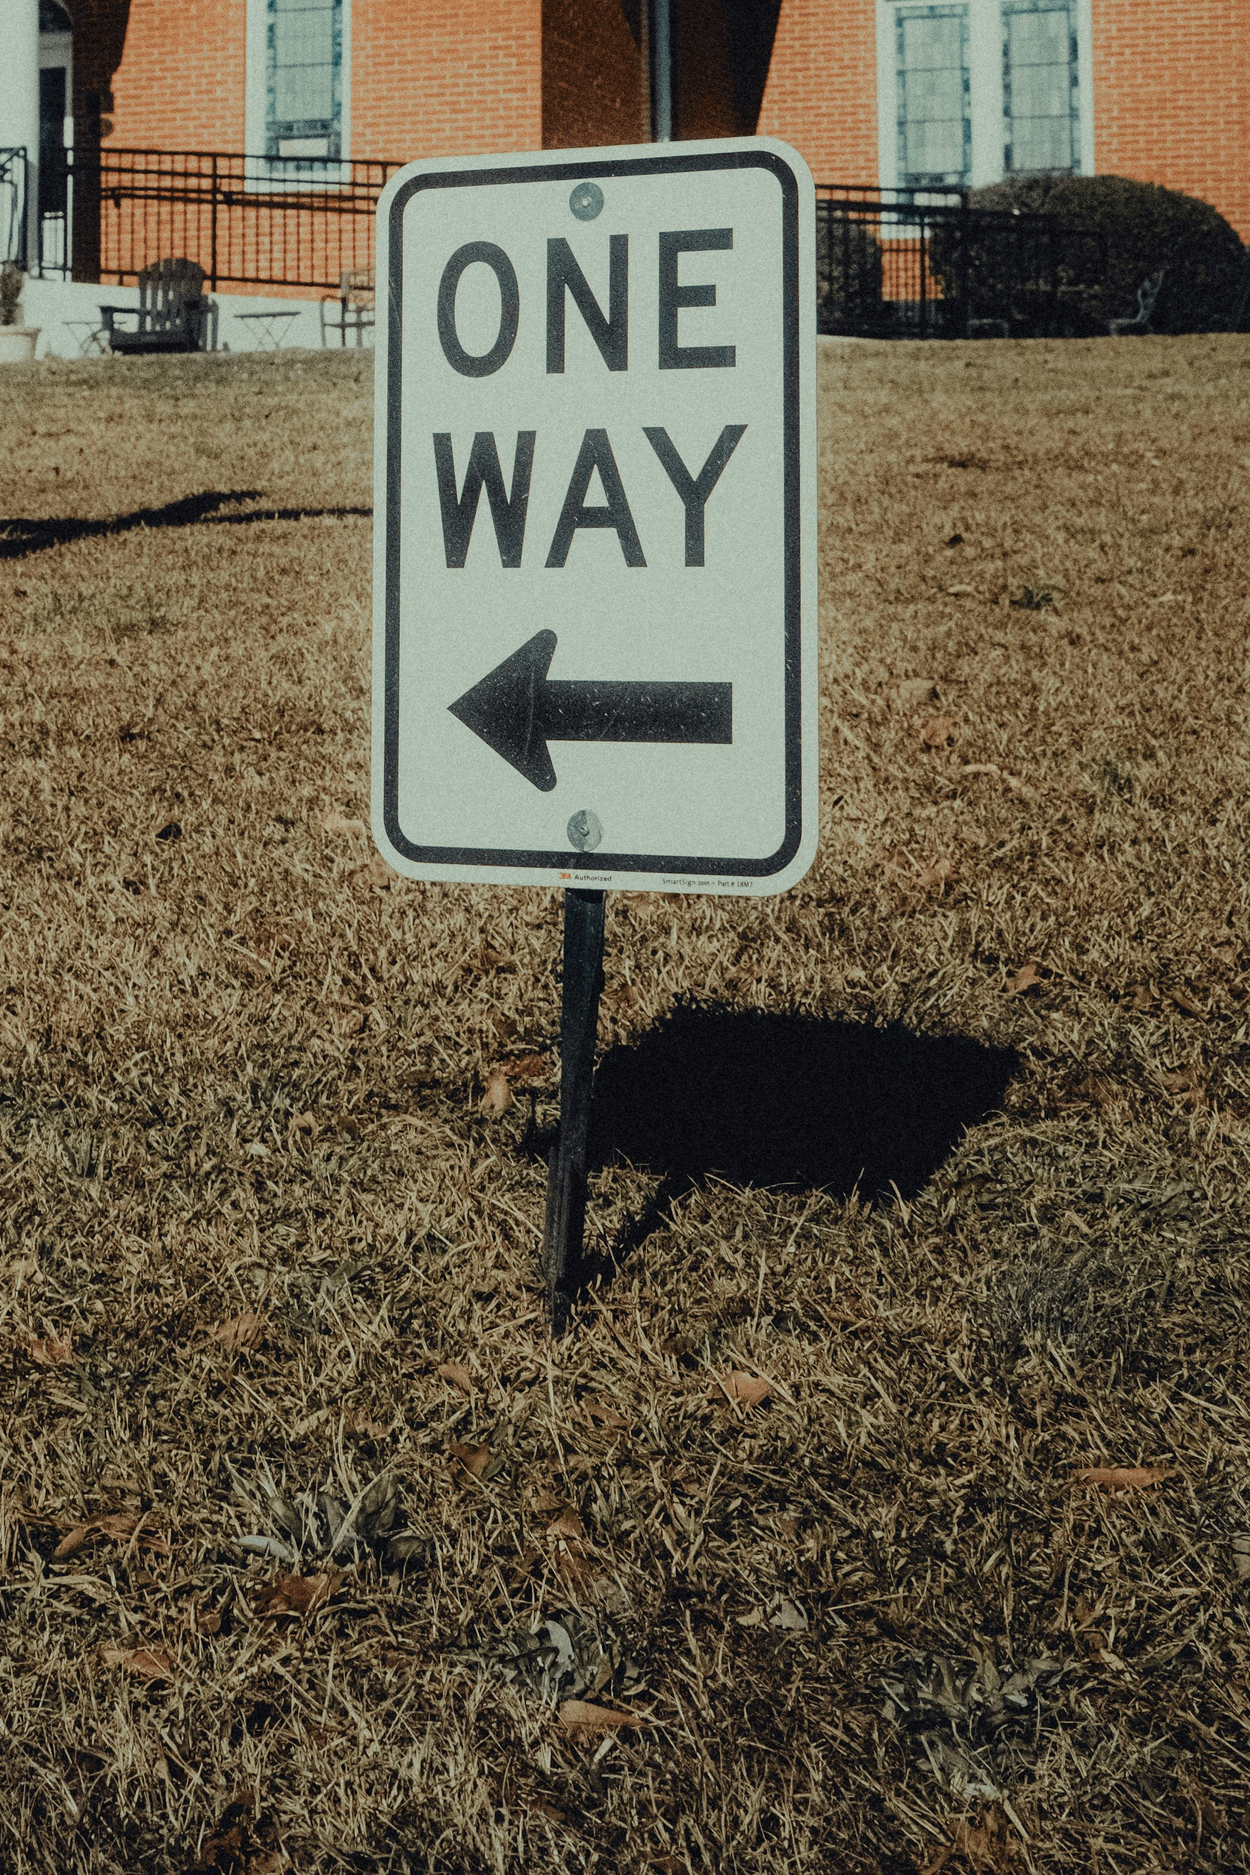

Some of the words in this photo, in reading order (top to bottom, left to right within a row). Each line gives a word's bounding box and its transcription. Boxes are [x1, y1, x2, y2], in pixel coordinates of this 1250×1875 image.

[437, 227, 737, 378] ONE
[432, 424, 748, 569] WAY
[574, 874, 612, 882] Authorized
